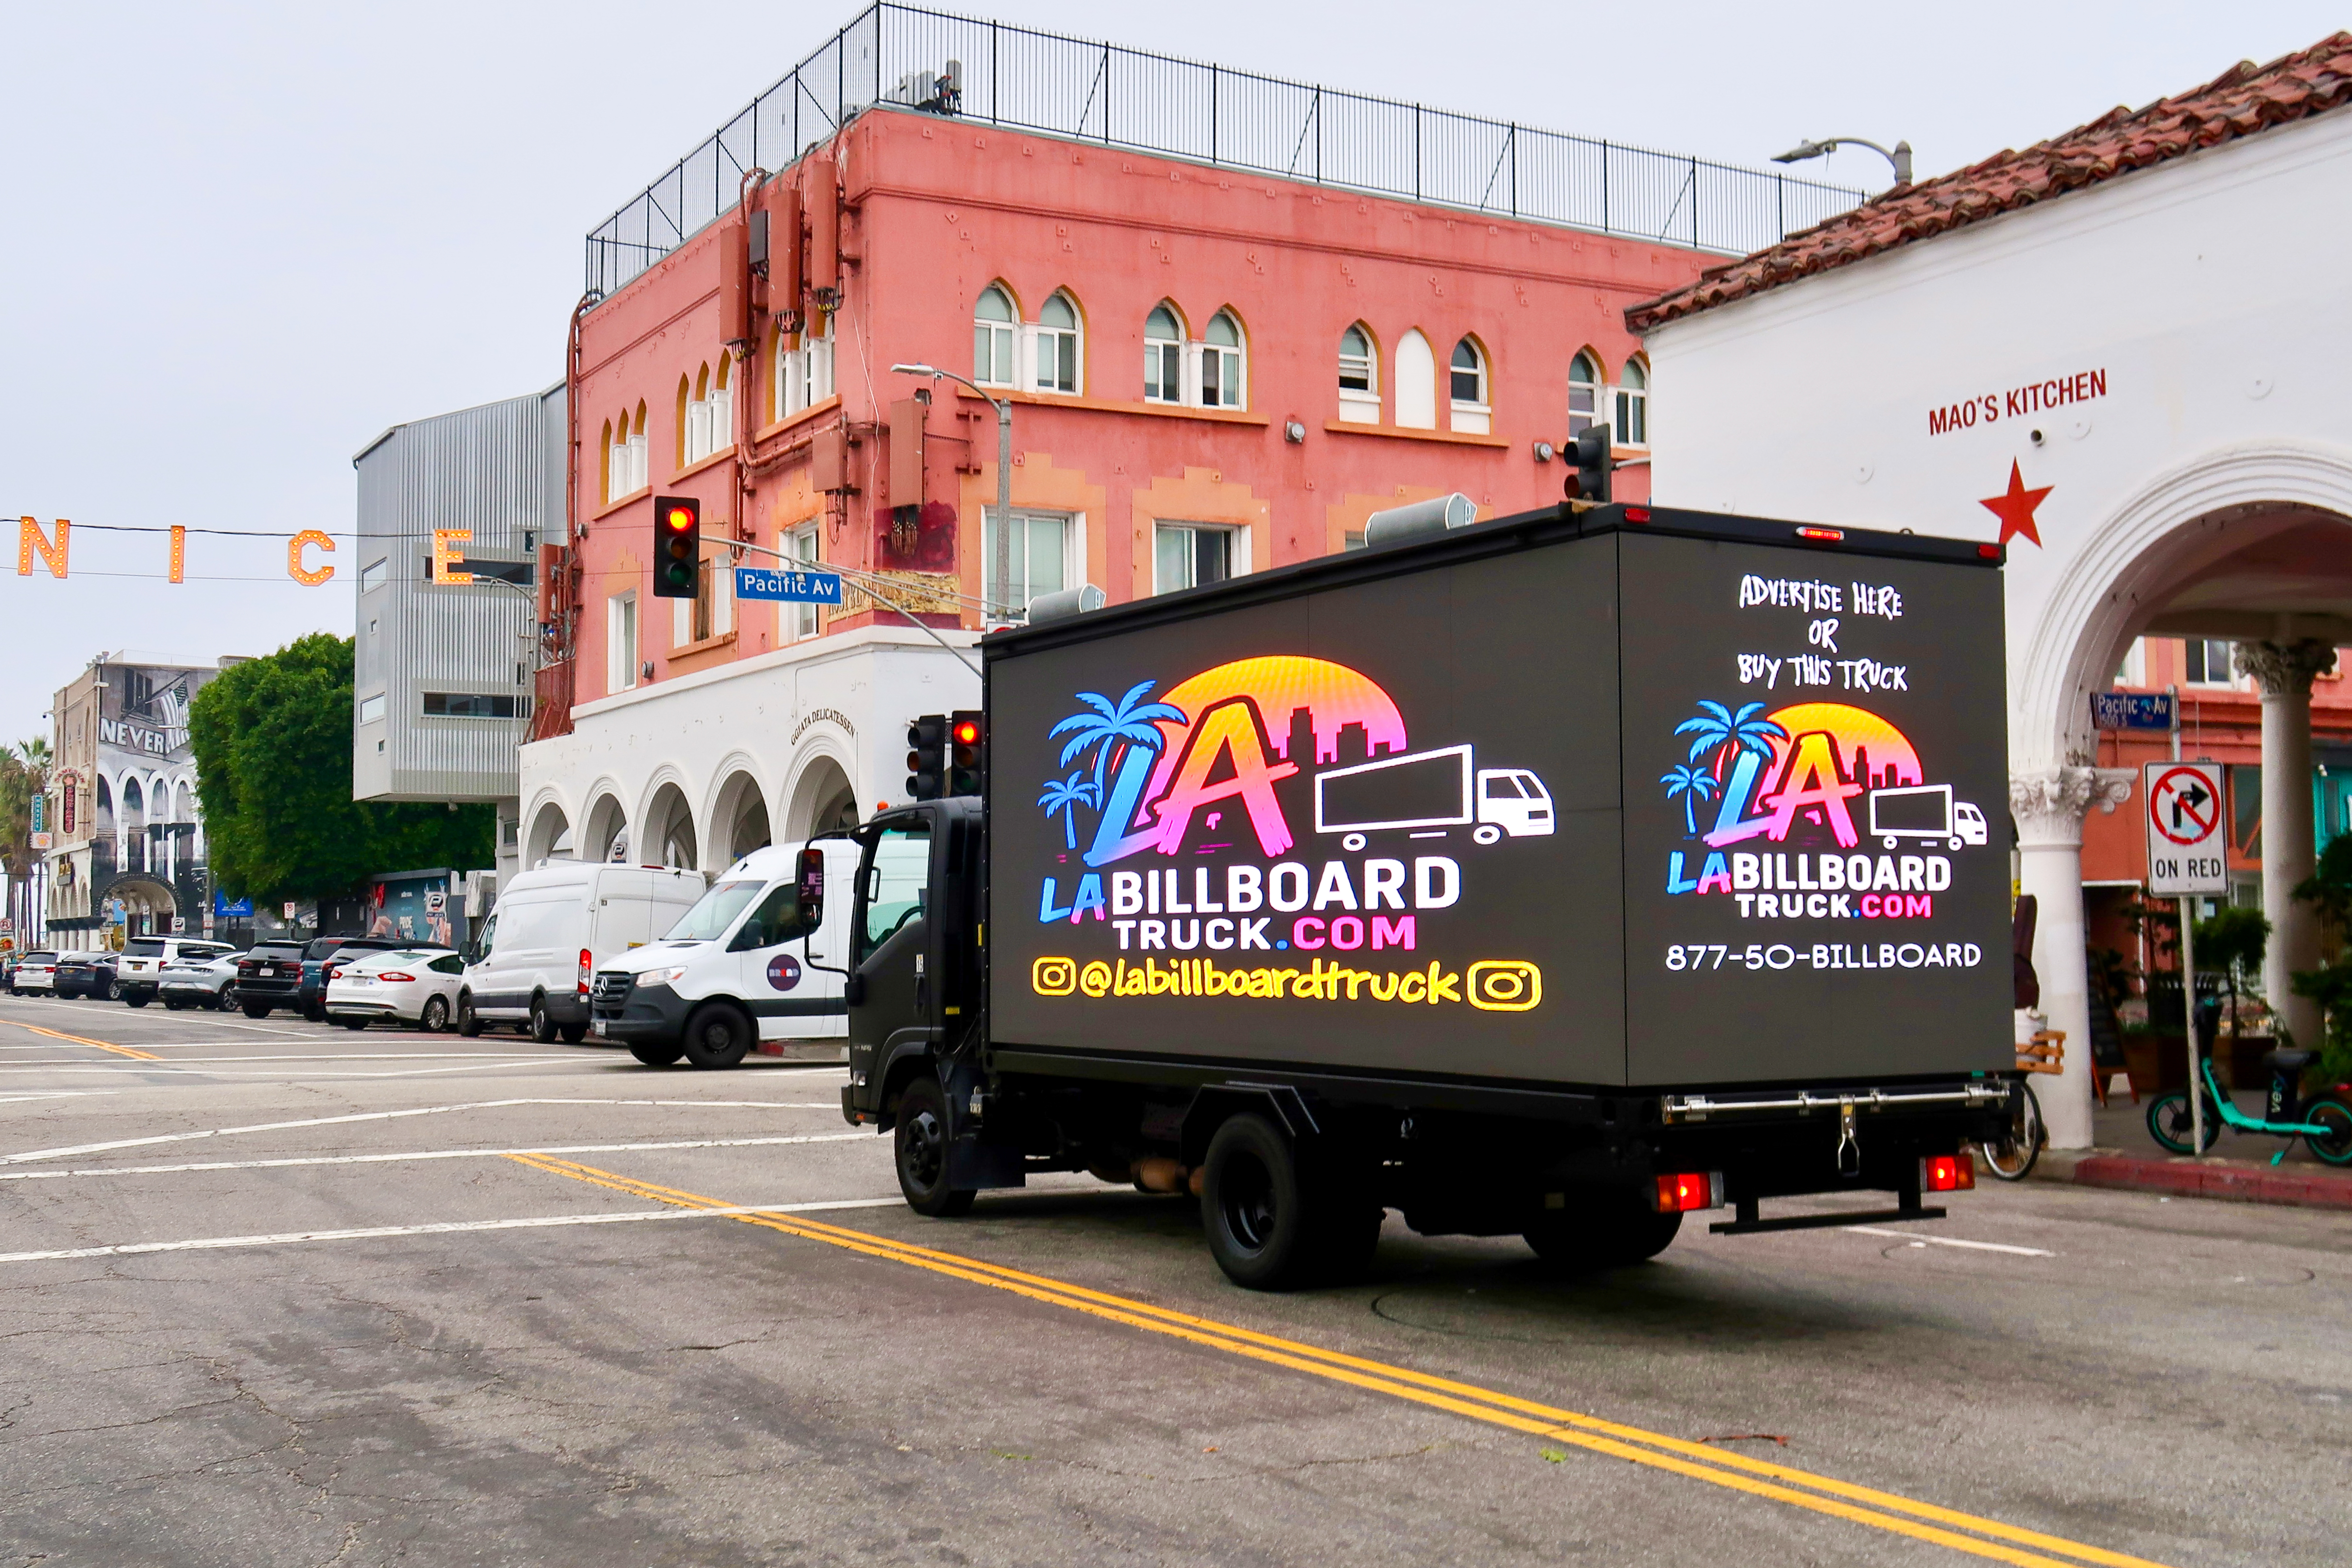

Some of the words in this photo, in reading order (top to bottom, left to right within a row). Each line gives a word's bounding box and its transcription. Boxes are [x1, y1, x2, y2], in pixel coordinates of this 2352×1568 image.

[1929, 395, 1999, 436] MAO'S
[2007, 368, 2107, 418] KITCHEN
[744, 574, 807, 594] Pacific
[813, 579, 834, 596] Av
[1739, 574, 1843, 613] ADVERTISE
[1852, 582, 1903, 620] HERE
[1808, 618, 1839, 653] OR
[1737, 653, 1782, 690] BUY
[1786, 654, 1833, 687] THIS
[1836, 658, 1908, 693] TRUCK
[2098, 694, 2138, 715] Pacific
[2154, 696, 2167, 714] Av
[100, 717, 164, 754] NEVER
[791, 715, 811, 746] GGIATA
[812, 708, 856, 739] DELICATESSEN
[55, 768, 86, 784] SAMESUN
[1082, 700, 1300, 868] LA
[1702, 733, 1864, 848] LA
[2156, 859, 2179, 878] ON
[2188, 858, 2221, 878] RED
[1734, 893, 1933, 919] TRUCK.COM
[1112, 915, 1417, 952] TRUCK.COM
[1665, 943, 1982, 971] 877-50-BILLBOARD
[1080, 957, 1462, 1005] @labillboardtruck
